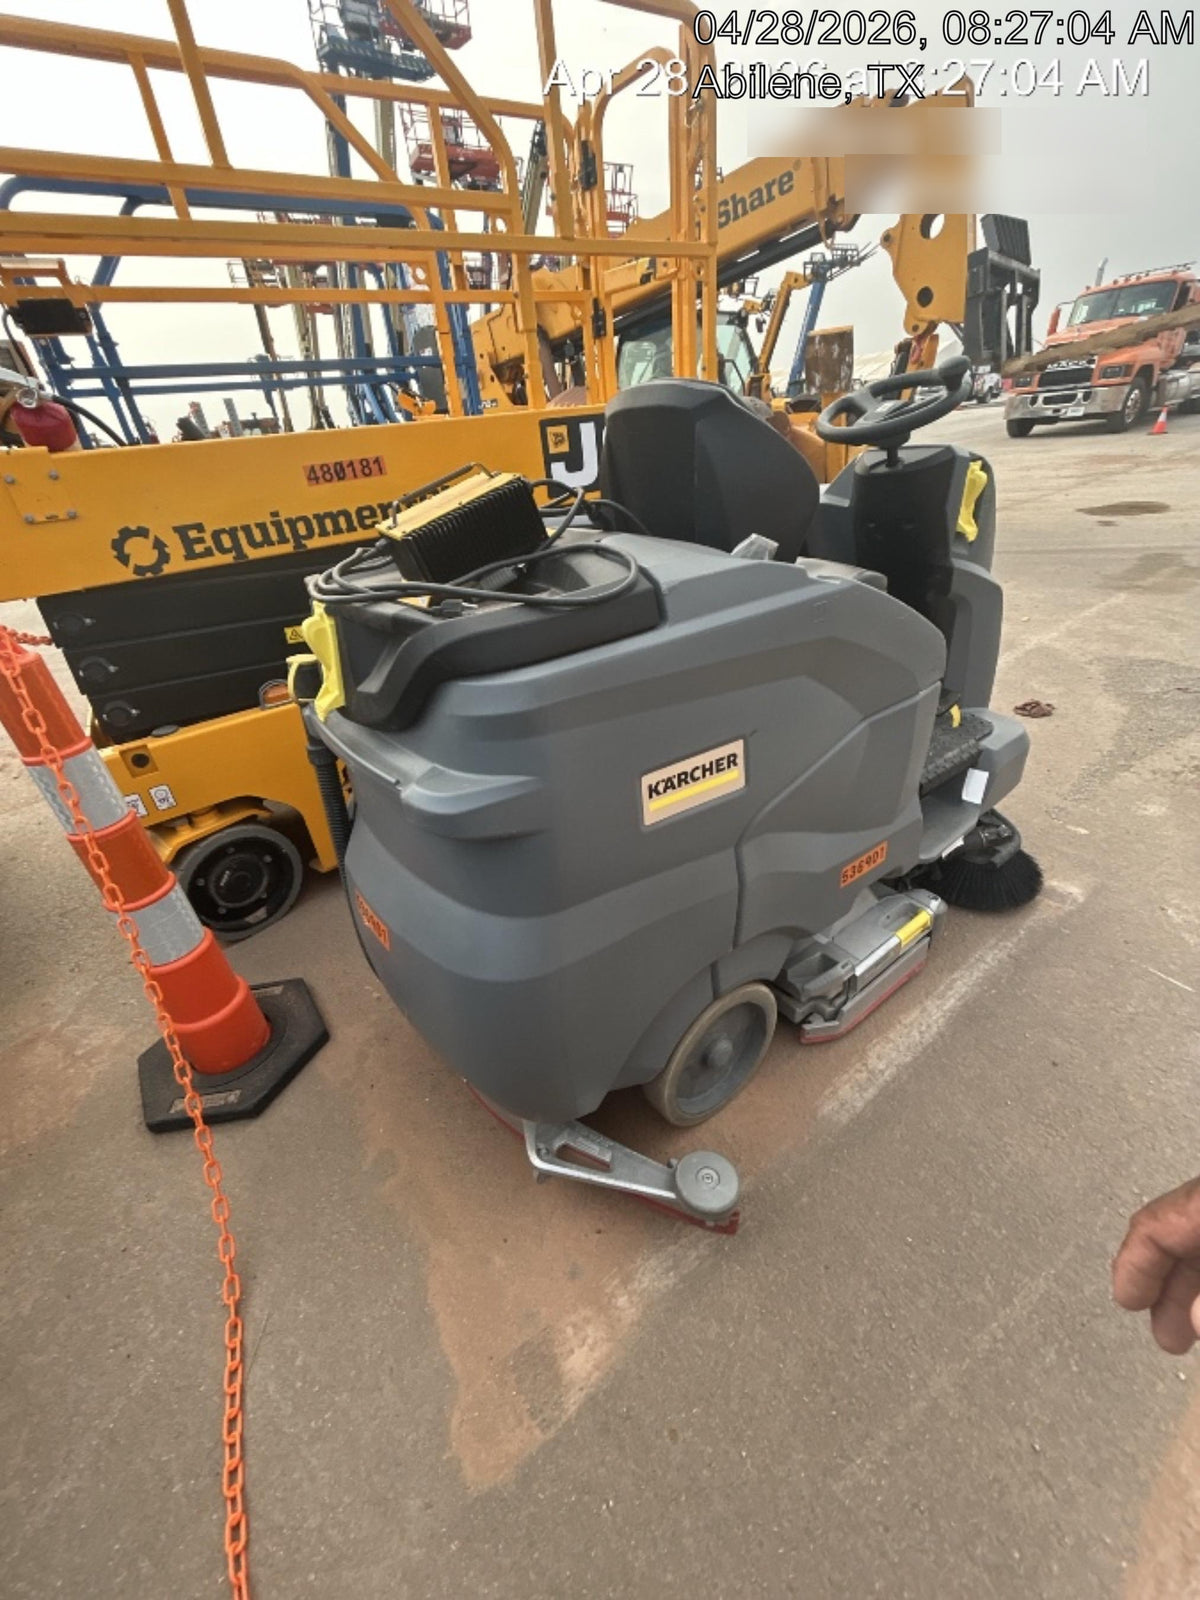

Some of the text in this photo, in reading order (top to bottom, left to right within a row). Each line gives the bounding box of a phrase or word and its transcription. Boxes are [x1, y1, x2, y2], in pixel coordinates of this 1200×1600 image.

[717, 169, 795, 230] Share
[306, 455, 384, 485] 480181
[647, 752, 739, 800] KÄRCHER
